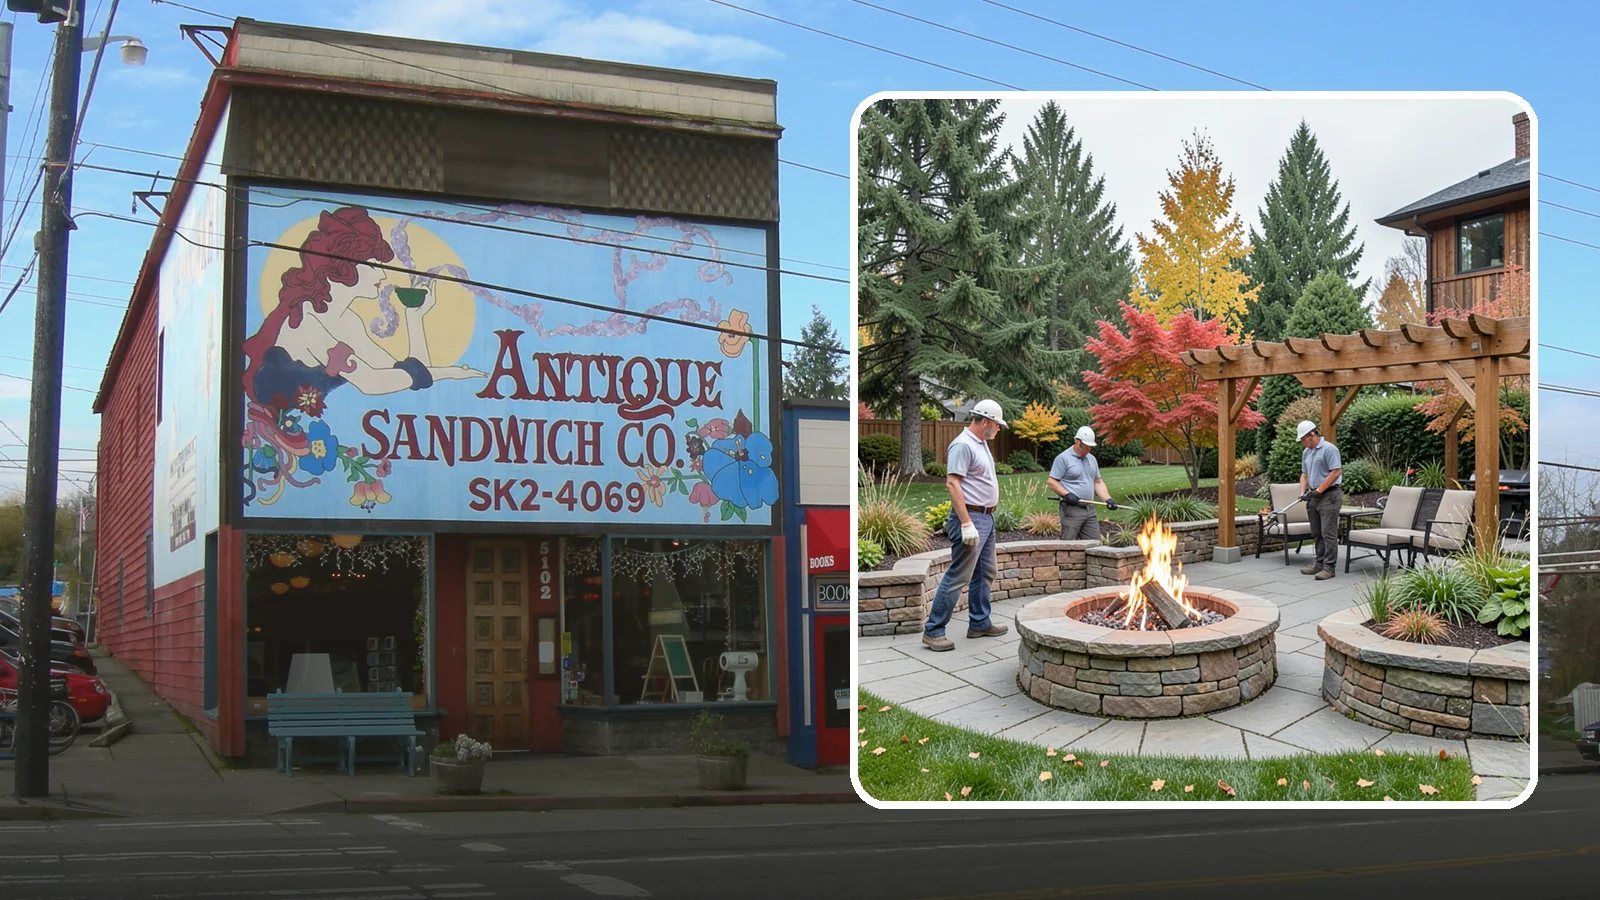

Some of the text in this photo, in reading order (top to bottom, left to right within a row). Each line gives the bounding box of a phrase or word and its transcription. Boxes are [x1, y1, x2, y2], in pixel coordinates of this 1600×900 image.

[476, 329, 724, 421] ANTIQUE
[361, 408, 686, 469] SANDWICH CO.
[468, 476, 646, 514] SK2-4069
[540, 541, 552, 600] 5102
[809, 555, 835, 569] BOOKS
